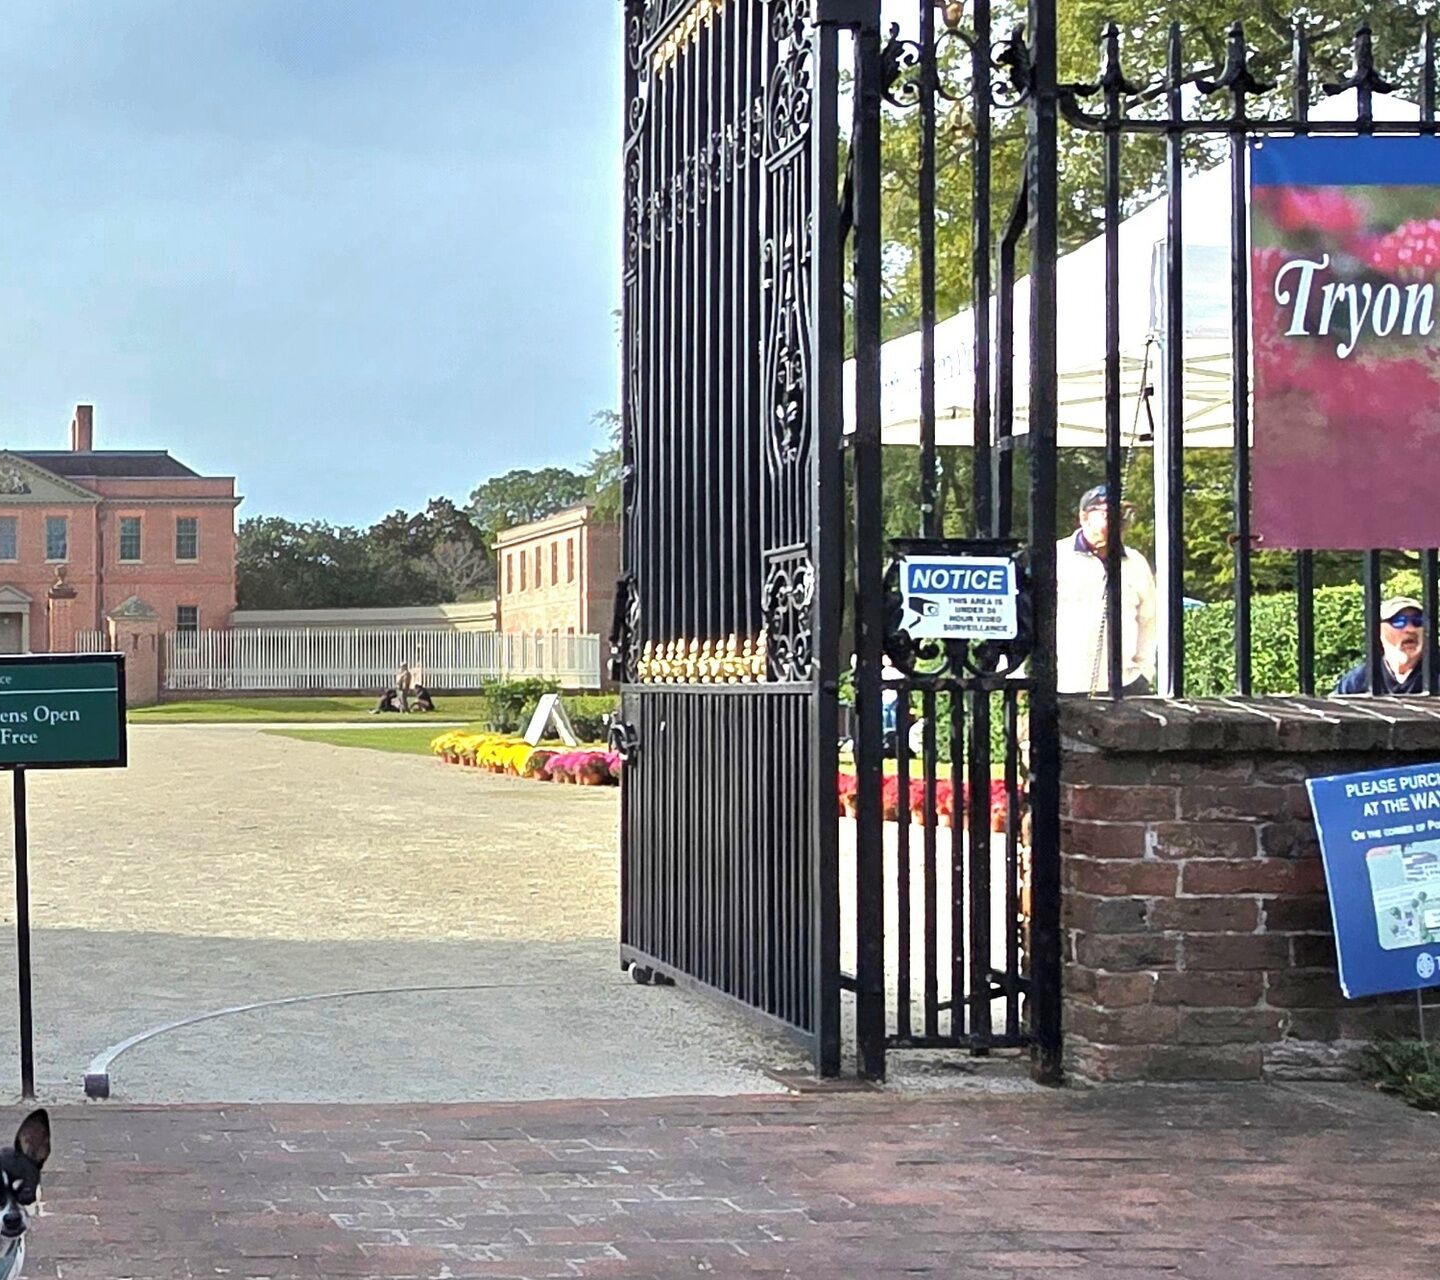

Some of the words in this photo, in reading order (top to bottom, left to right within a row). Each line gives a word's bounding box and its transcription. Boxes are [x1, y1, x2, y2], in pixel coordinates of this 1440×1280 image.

[1275, 253, 1436, 359] Tryon
[911, 568, 1005, 590] NOTICE
[948, 597, 967, 605] THIS
[970, 597, 992, 605] AREA
[954, 606, 984, 614] UNDER
[943, 623, 1008, 632] SURVEILLANCE
[33, 706, 80, 725] Open
[0, 728, 38, 745] Free
[1345, 778, 1398, 798] PLEASE
[1363, 801, 1379, 817] AT
[1381, 797, 1410, 814] THE
